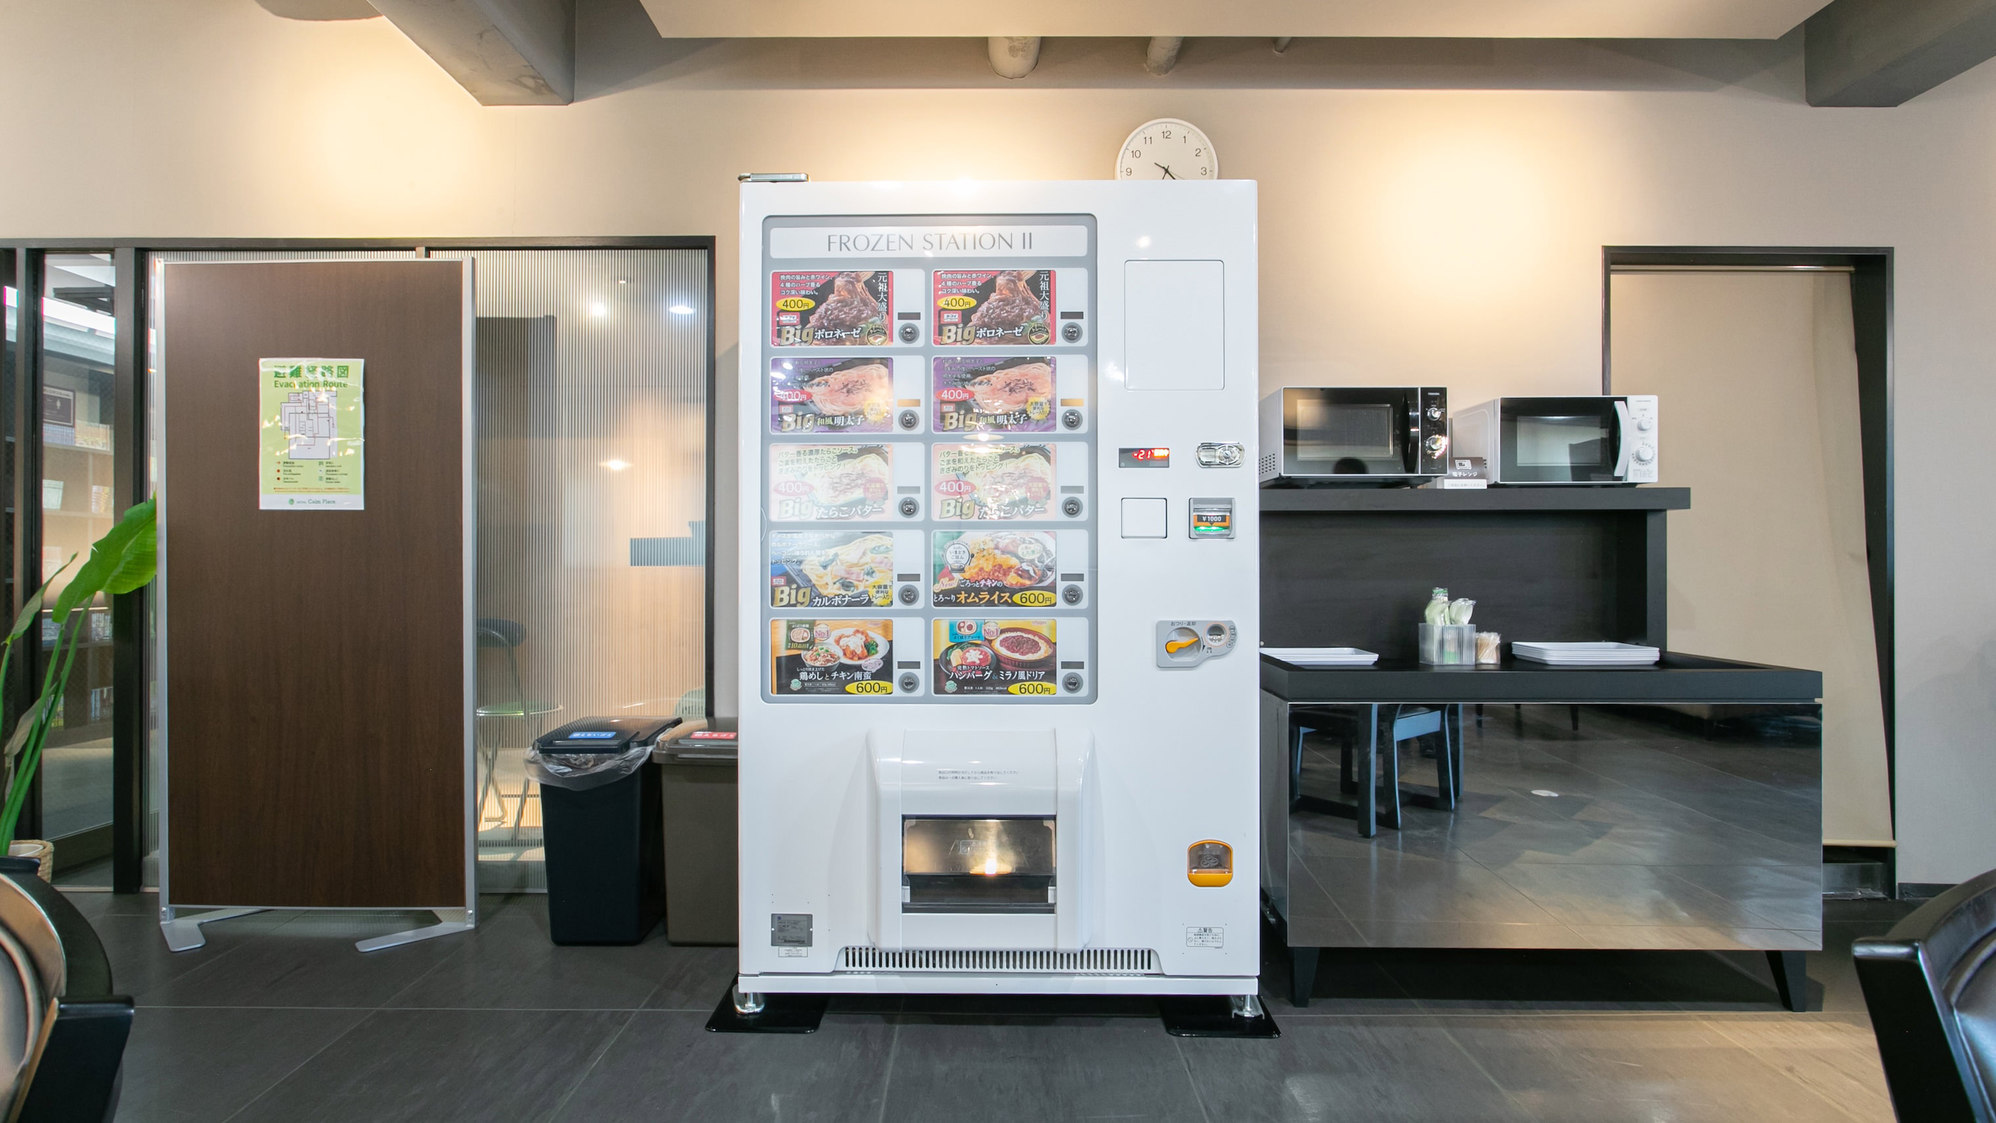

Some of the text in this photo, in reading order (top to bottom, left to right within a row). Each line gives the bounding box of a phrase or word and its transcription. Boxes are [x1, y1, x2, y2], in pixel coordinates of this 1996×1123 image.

[1144, 136, 1153, 144] 11
[1161, 130, 1172, 139] 12
[1183, 135, 1187, 144] 1
[1131, 149, 1142, 158] 10
[1195, 148, 1202, 157] 2
[1125, 167, 1133, 176] 9
[1200, 167, 1208, 176] 3
[827, 232, 1032, 252] FROZEN STATION II
[1039, 270, 1049, 320] 元祖大盛り
[782, 299, 810, 309] 400円
[943, 297, 971, 308] 400円
[941, 323, 1024, 345] Big ボロネーゼ
[273, 380, 348, 388] Evacation Route
[941, 389, 969, 400] 400円
[943, 409, 977, 432] Big
[939, 481, 972, 493] 400円
[939, 497, 975, 520] Big
[773, 584, 870, 607] Big カルボナーラ
[1020, 592, 1052, 604] 600円
[856, 682, 888, 693] 600円
[1018, 682, 1051, 694] 600円
